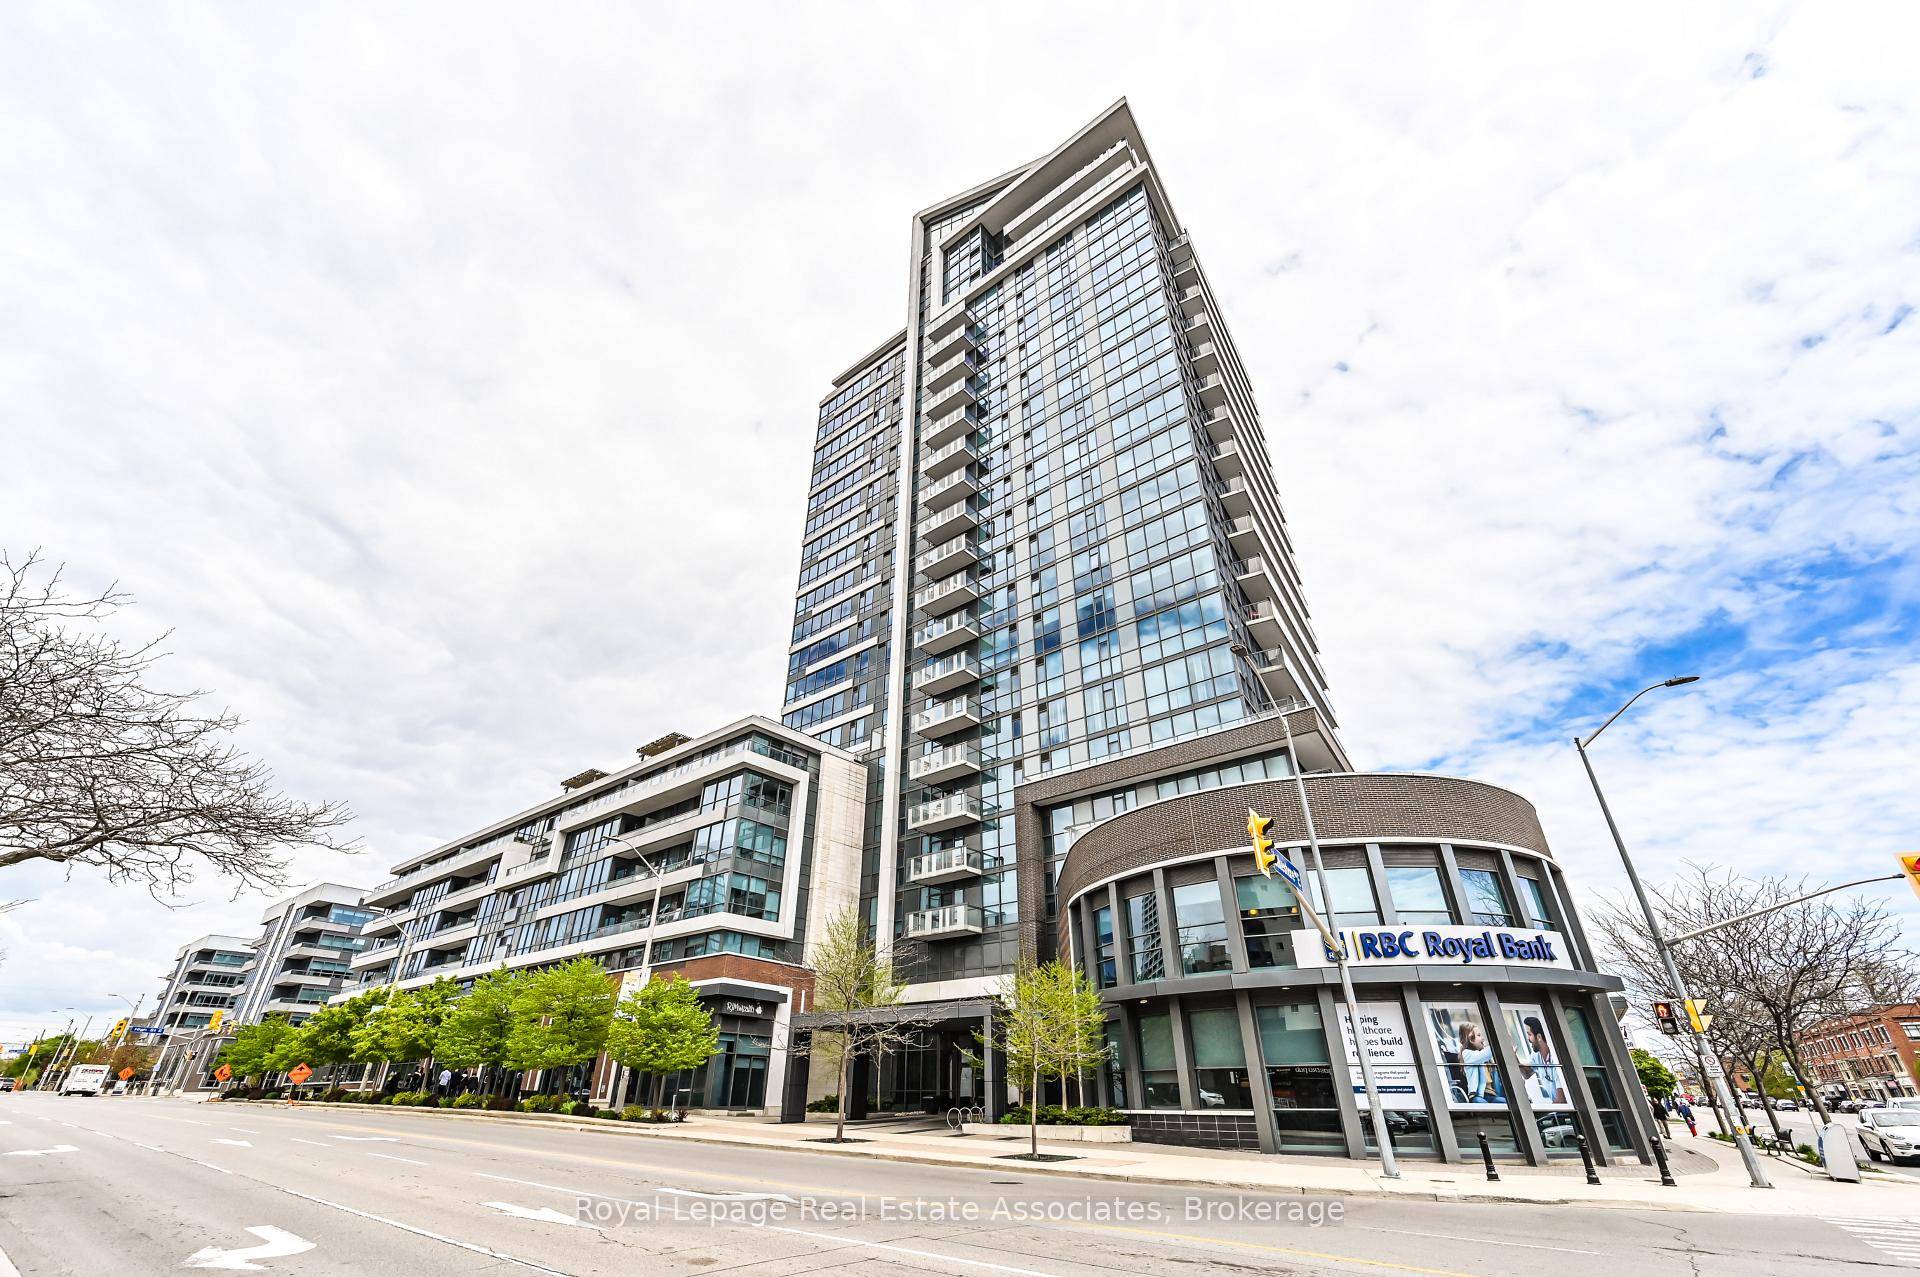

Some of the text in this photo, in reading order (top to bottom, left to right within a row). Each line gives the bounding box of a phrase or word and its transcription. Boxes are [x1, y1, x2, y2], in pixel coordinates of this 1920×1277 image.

[1359, 931, 1558, 963] RBC Royal Bank
[1344, 1014, 1379, 1026] Hping
[1380, 1036, 1403, 1046] build
